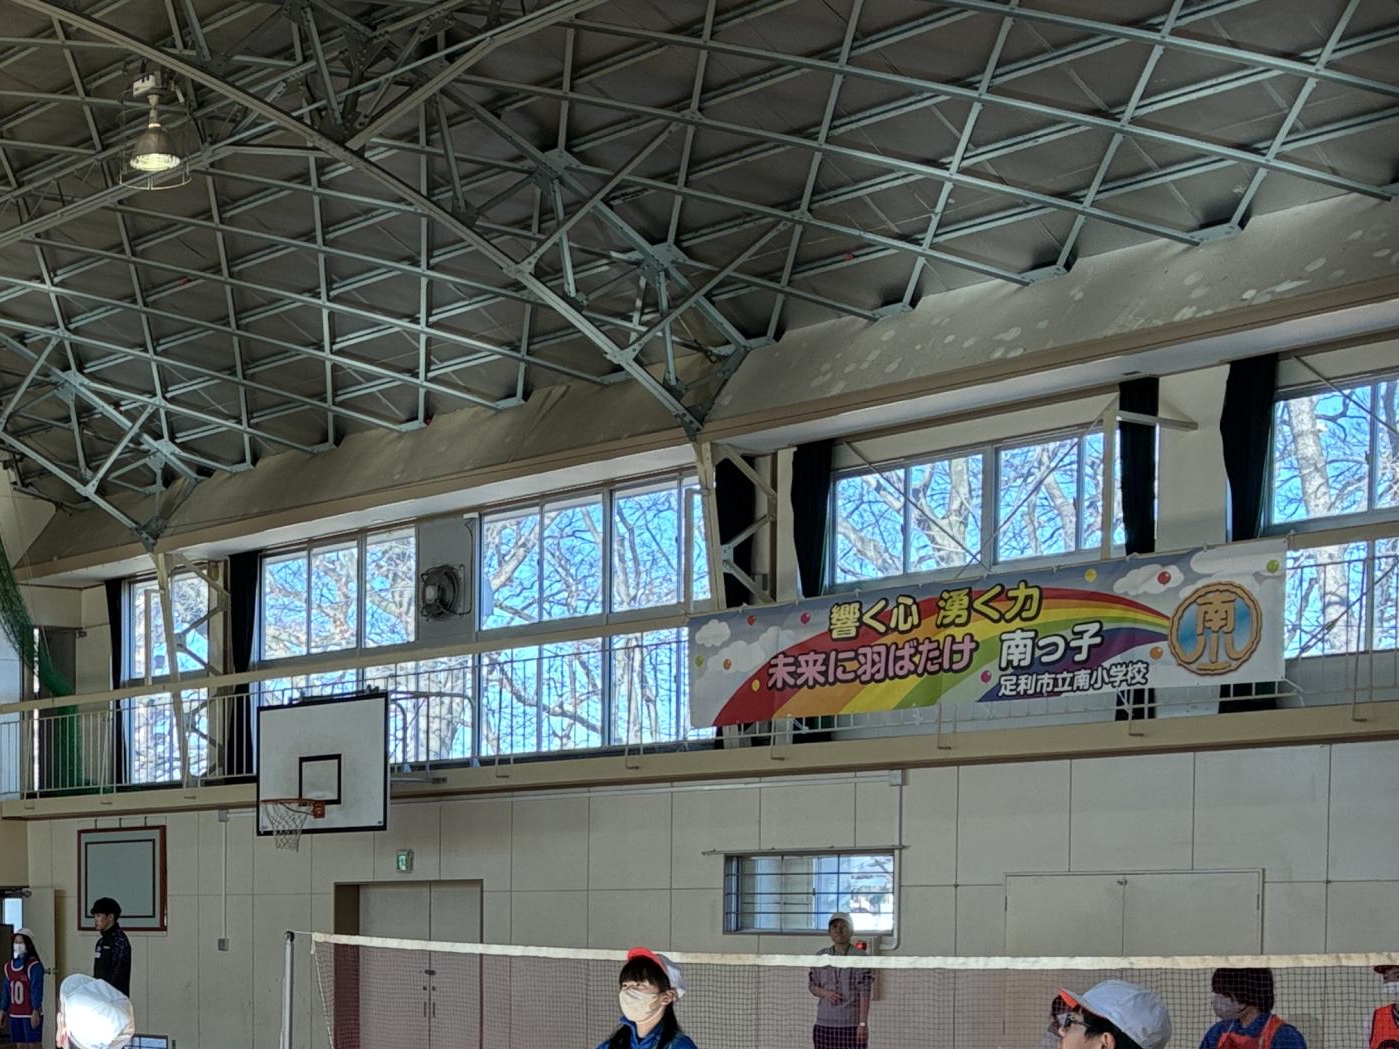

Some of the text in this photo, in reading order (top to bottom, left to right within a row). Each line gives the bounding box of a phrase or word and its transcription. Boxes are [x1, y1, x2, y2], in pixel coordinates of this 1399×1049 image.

[830, 580, 1042, 640] 響く心 湧く力
[767, 621, 1104, 690] 未来に羽ばたけ 南っ子
[998, 660, 1149, 697] 足利市立南小学校
[10, 980, 24, 1004] 10
